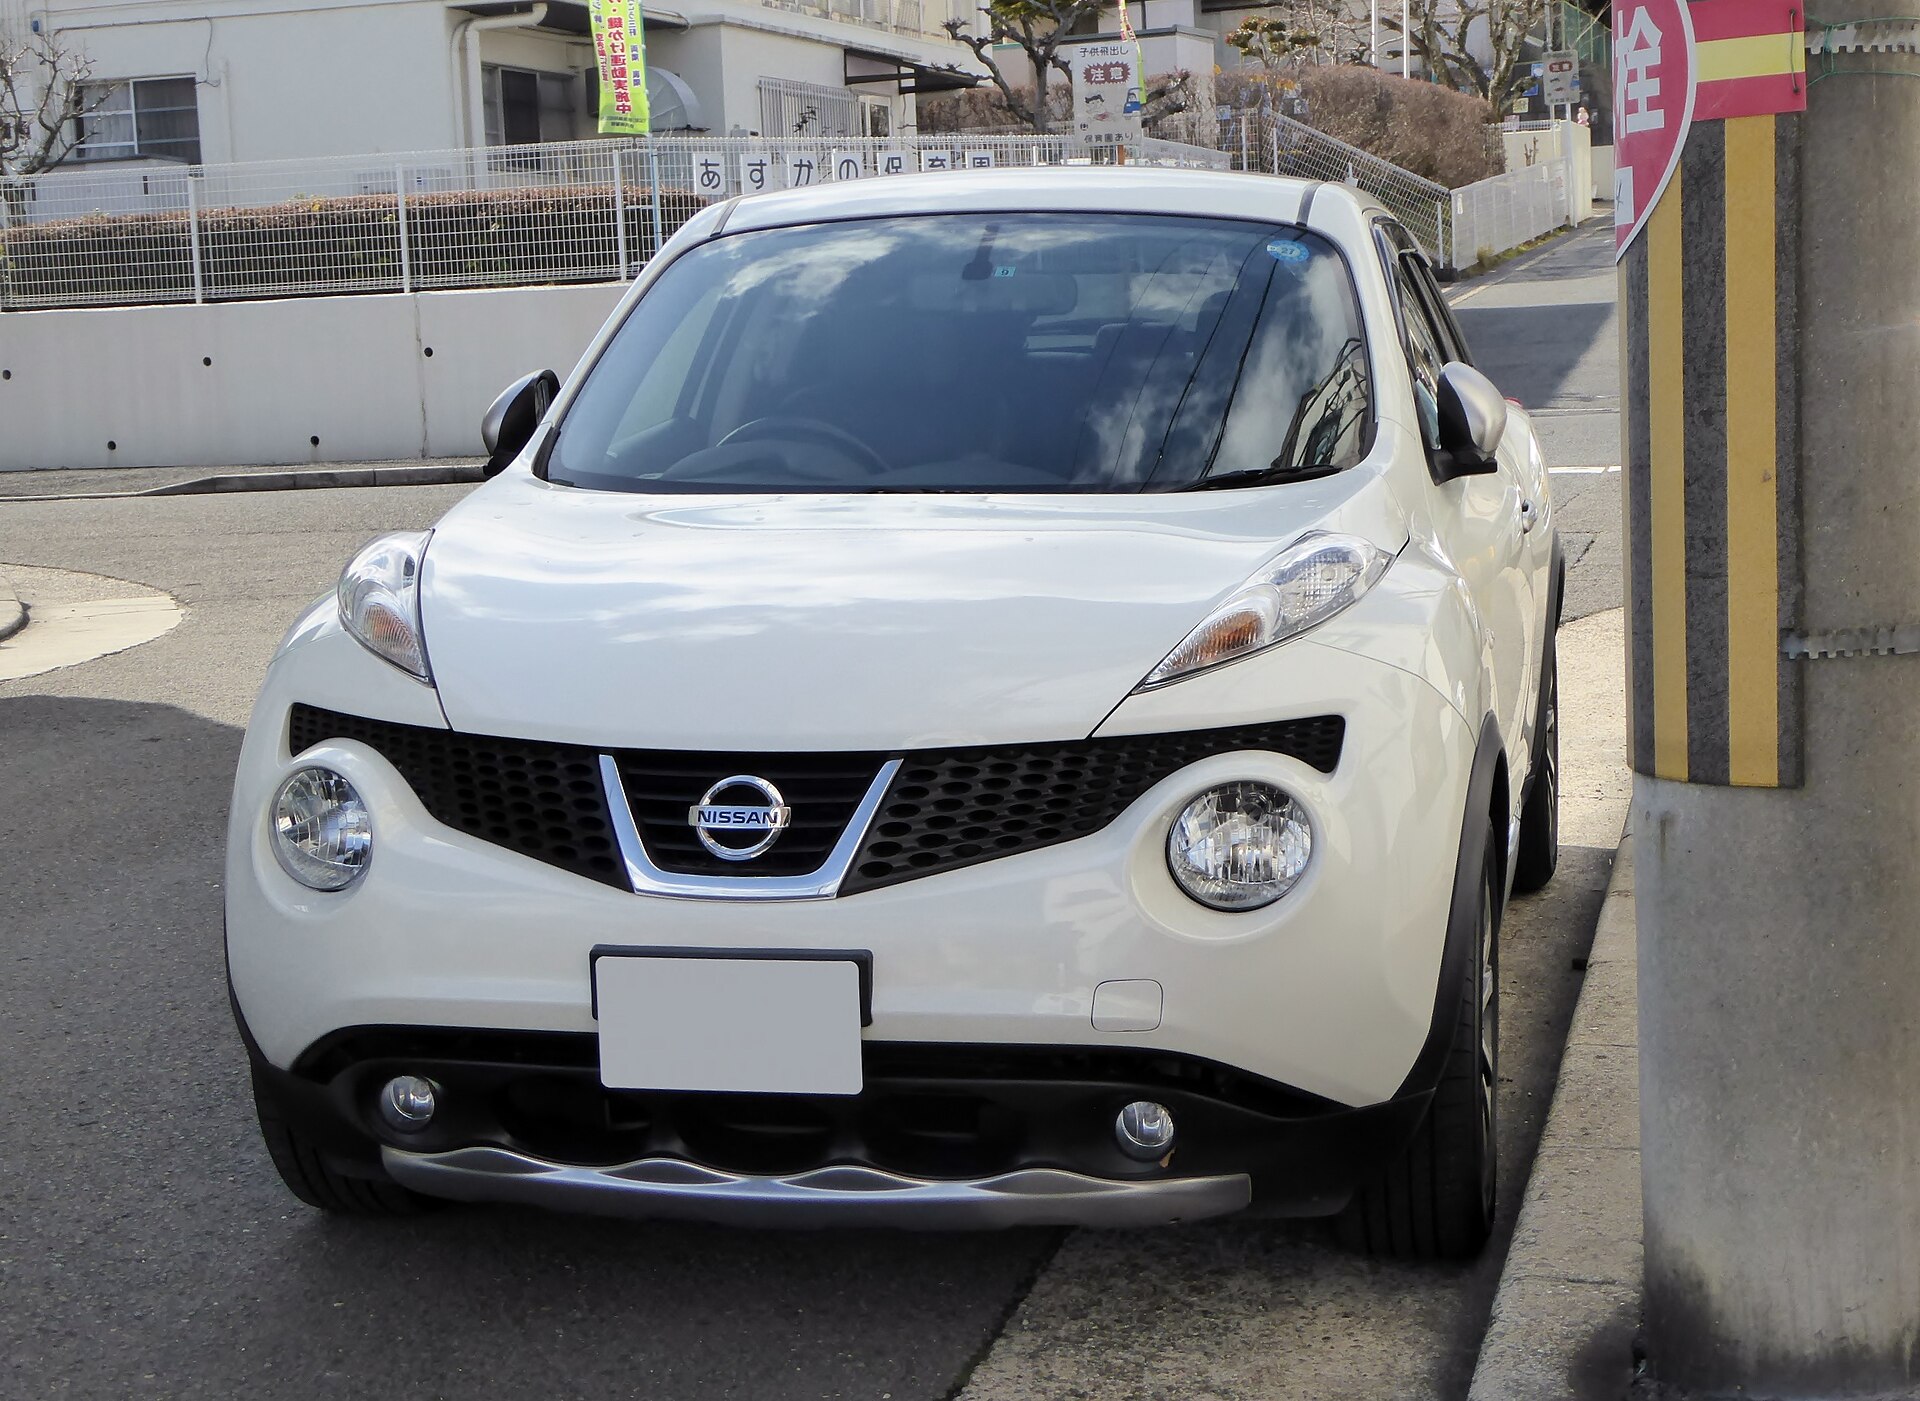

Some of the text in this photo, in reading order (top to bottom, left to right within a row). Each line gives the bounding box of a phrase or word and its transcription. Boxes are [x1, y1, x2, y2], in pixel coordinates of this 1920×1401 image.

[1080, 46, 1129, 58] 子供飛出し
[1090, 66, 1124, 81] 注意
[697, 810, 779, 825] NISSAN
